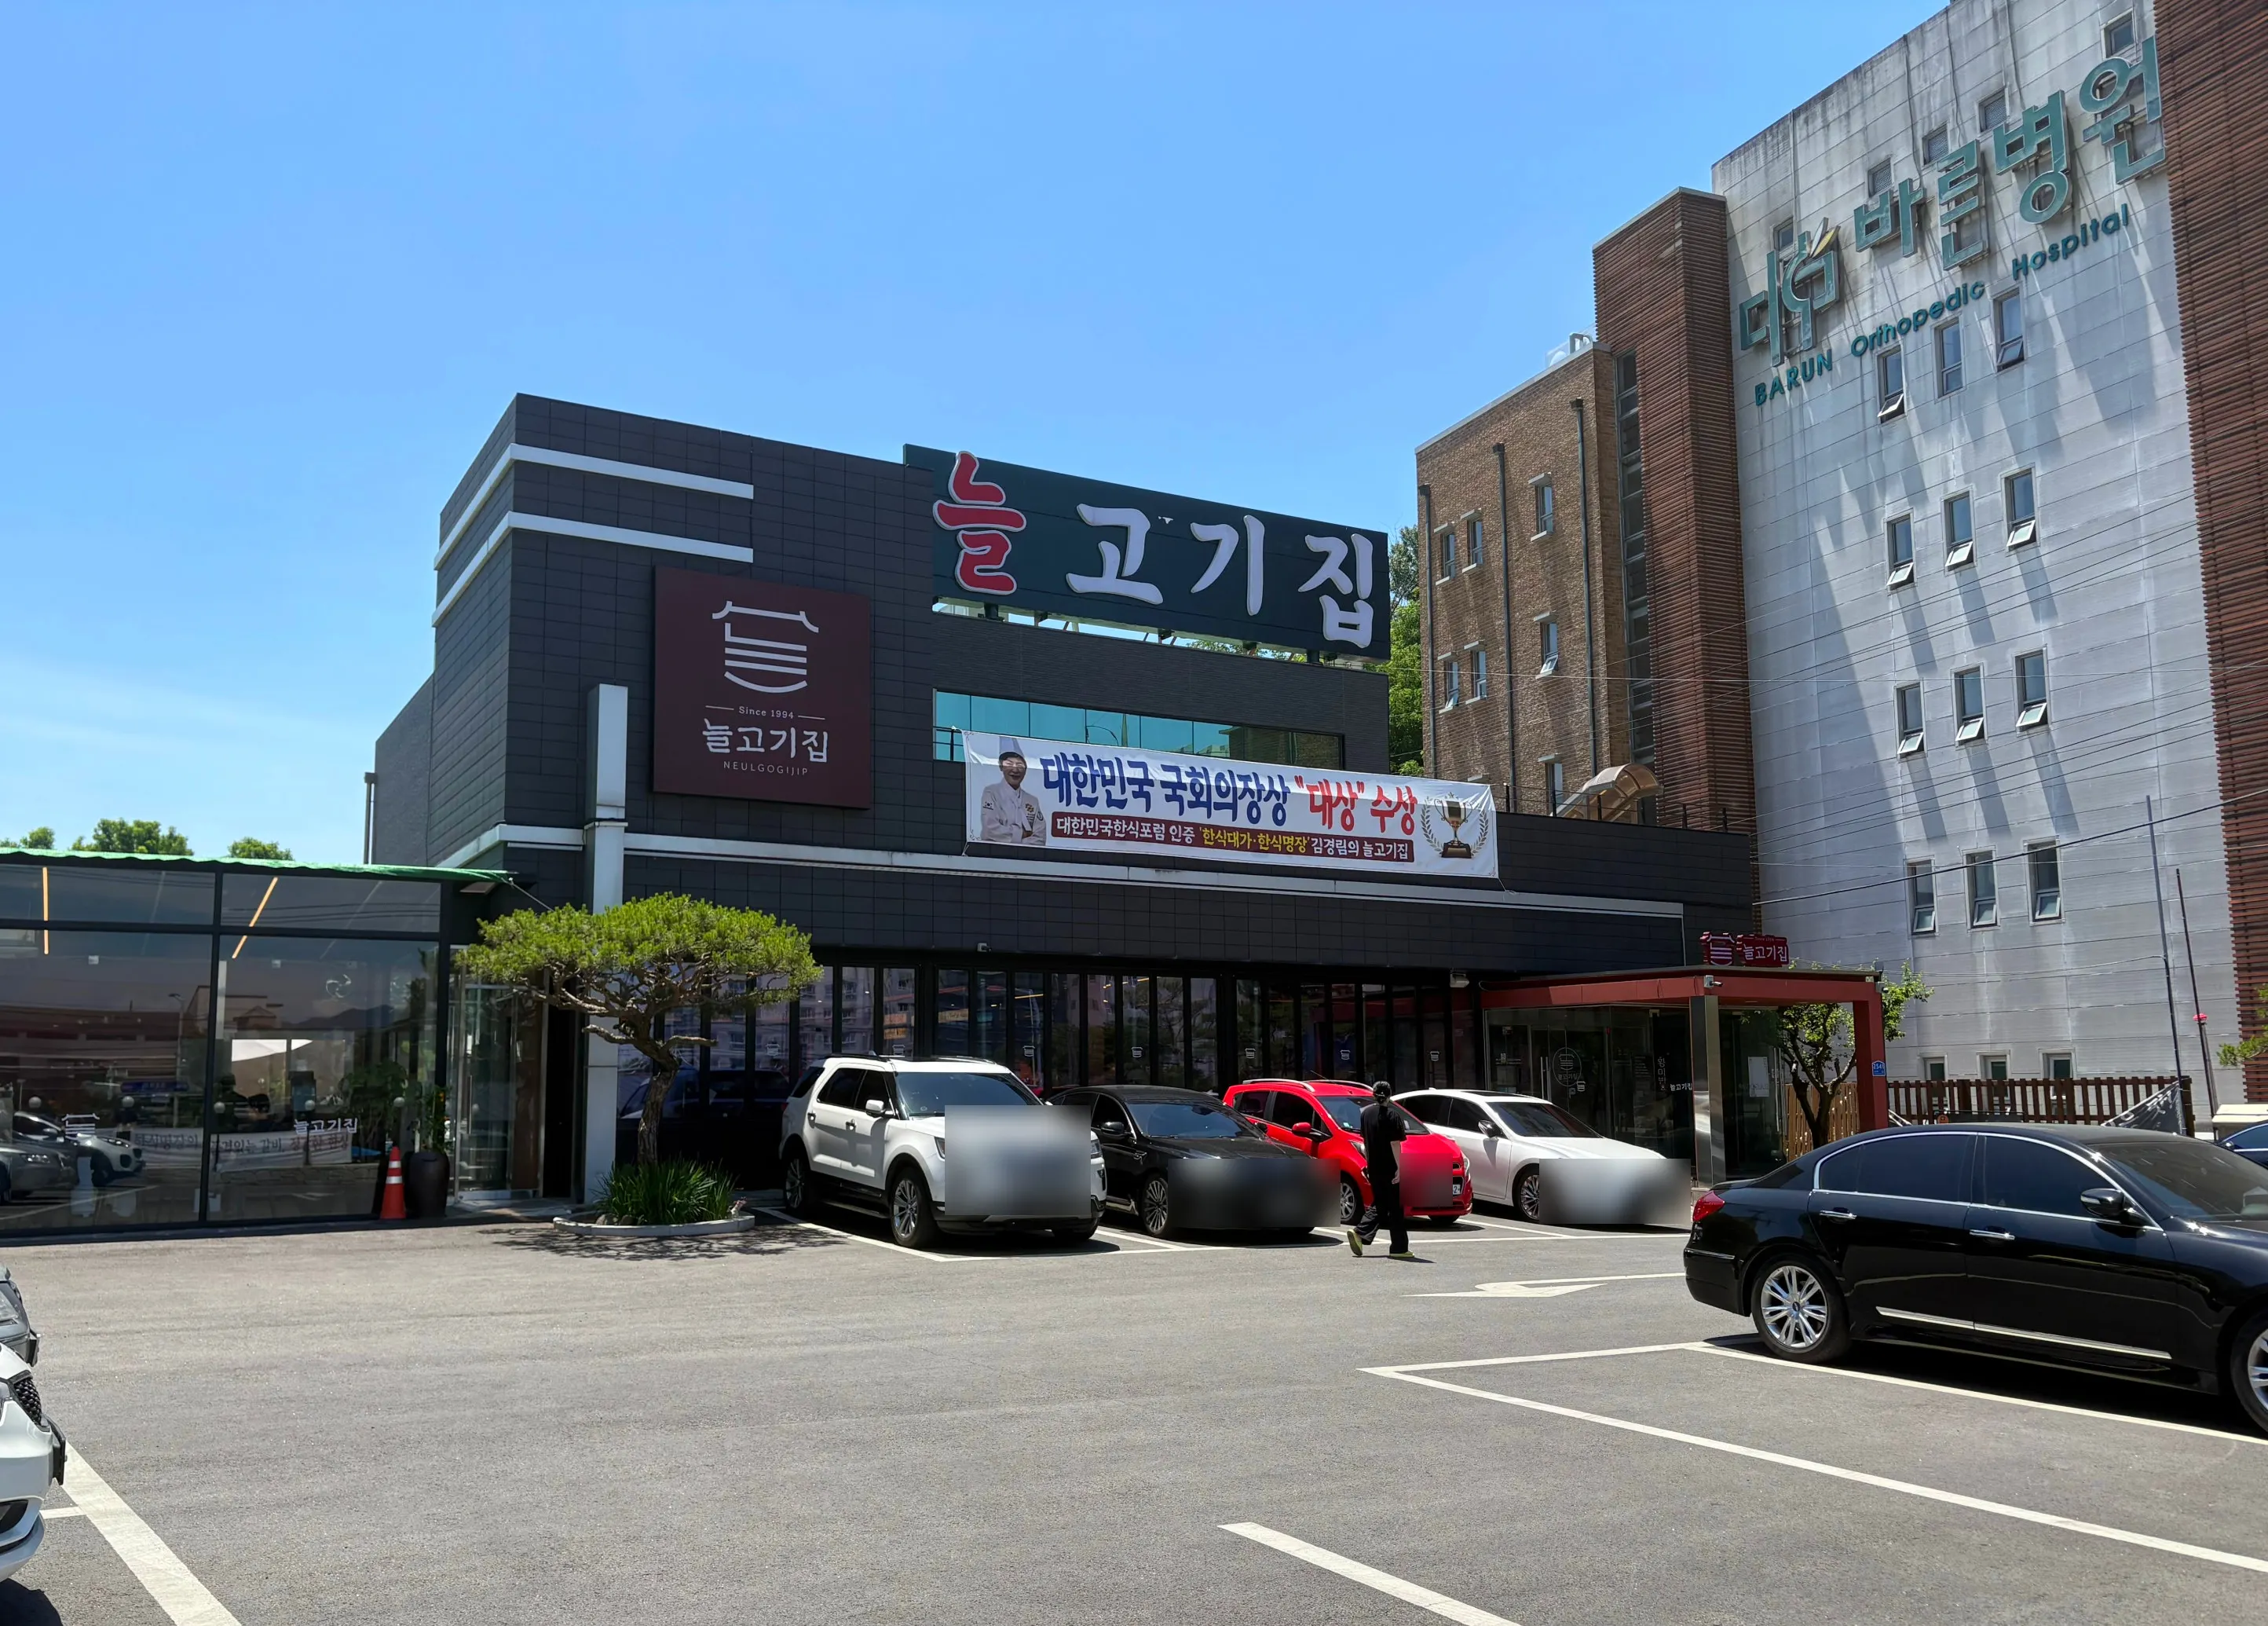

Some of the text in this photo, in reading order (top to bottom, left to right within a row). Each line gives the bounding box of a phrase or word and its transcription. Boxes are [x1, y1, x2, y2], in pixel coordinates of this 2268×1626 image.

[1754, 350, 1833, 406] BARUN
[1851, 280, 1985, 357] Orthopedic
[2012, 203, 2129, 280] Hospital
[739, 706, 794, 719] Since 1994
[702, 718, 829, 763] 늘고기집
[723, 761, 808, 776] NEULGOGIJIP
[1040, 752, 1154, 813] 대한민국
[1161, 764, 1291, 826] 국회의장상
[1370, 786, 1418, 836] 수상
[1056, 816, 1165, 841] 대한민국한식포럼
[1169, 825, 1195, 844] 인증
[1363, 841, 1409, 860] 늘고기집
[1743, 943, 1787, 961] 늘고기집
[294, 1118, 358, 1135] 늘고기집
